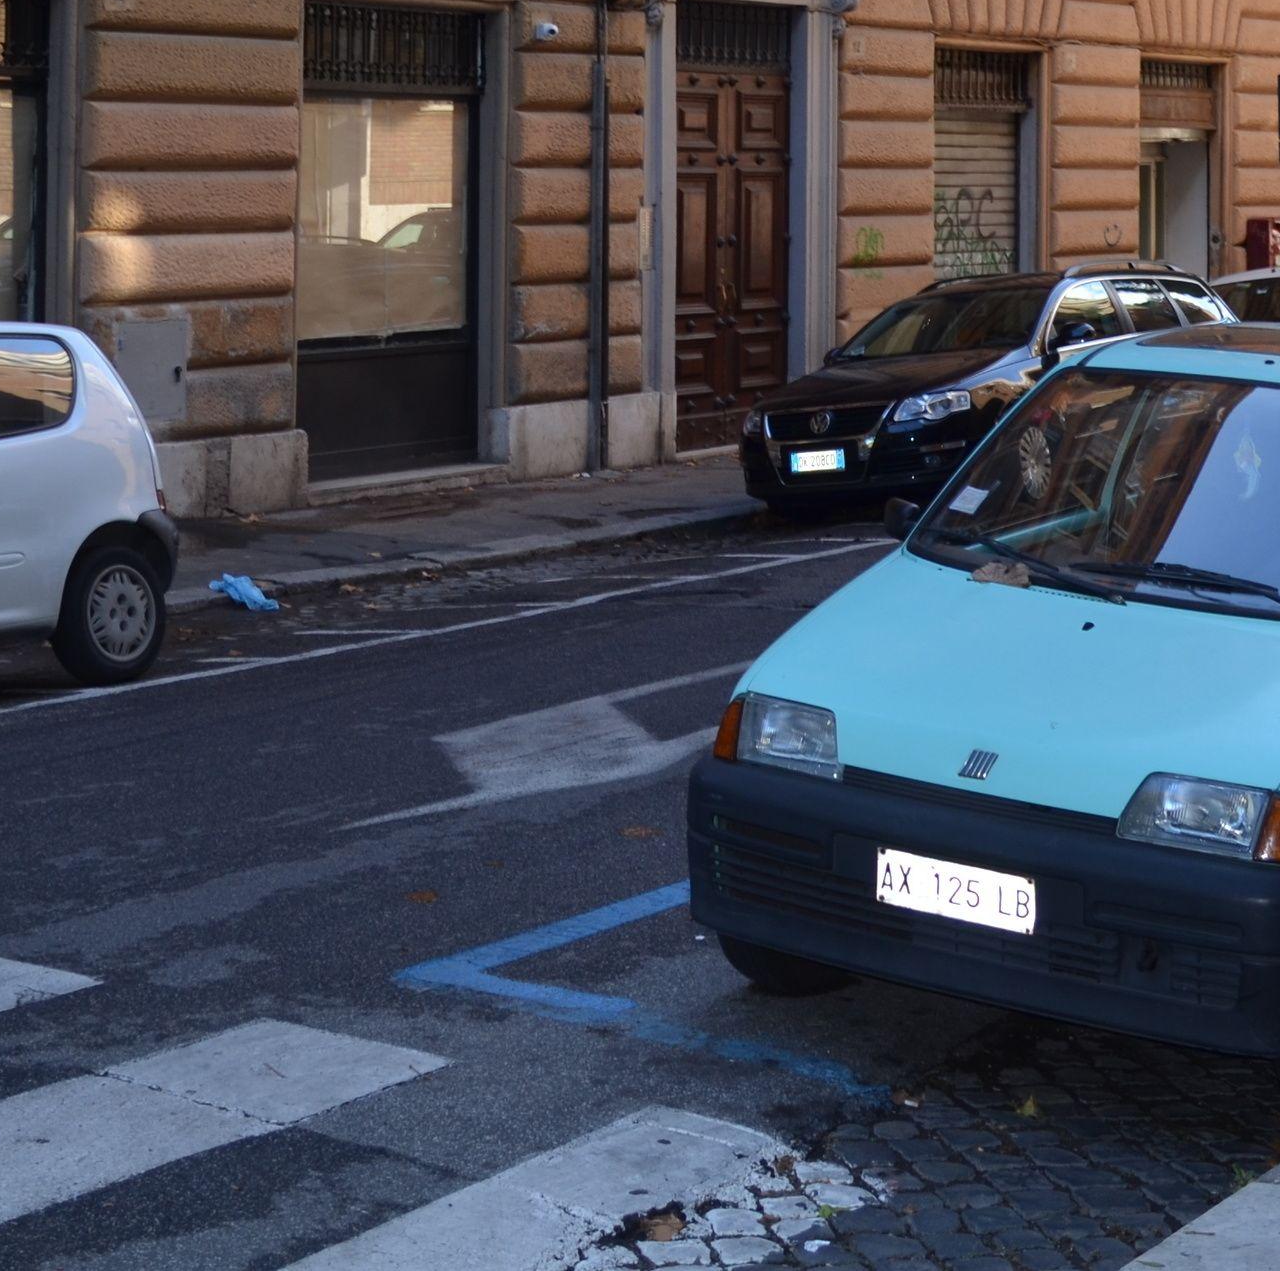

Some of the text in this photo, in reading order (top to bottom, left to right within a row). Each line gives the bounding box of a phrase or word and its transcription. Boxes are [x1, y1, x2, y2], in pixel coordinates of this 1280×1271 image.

[881, 862, 1030, 919] AX 125 LB
